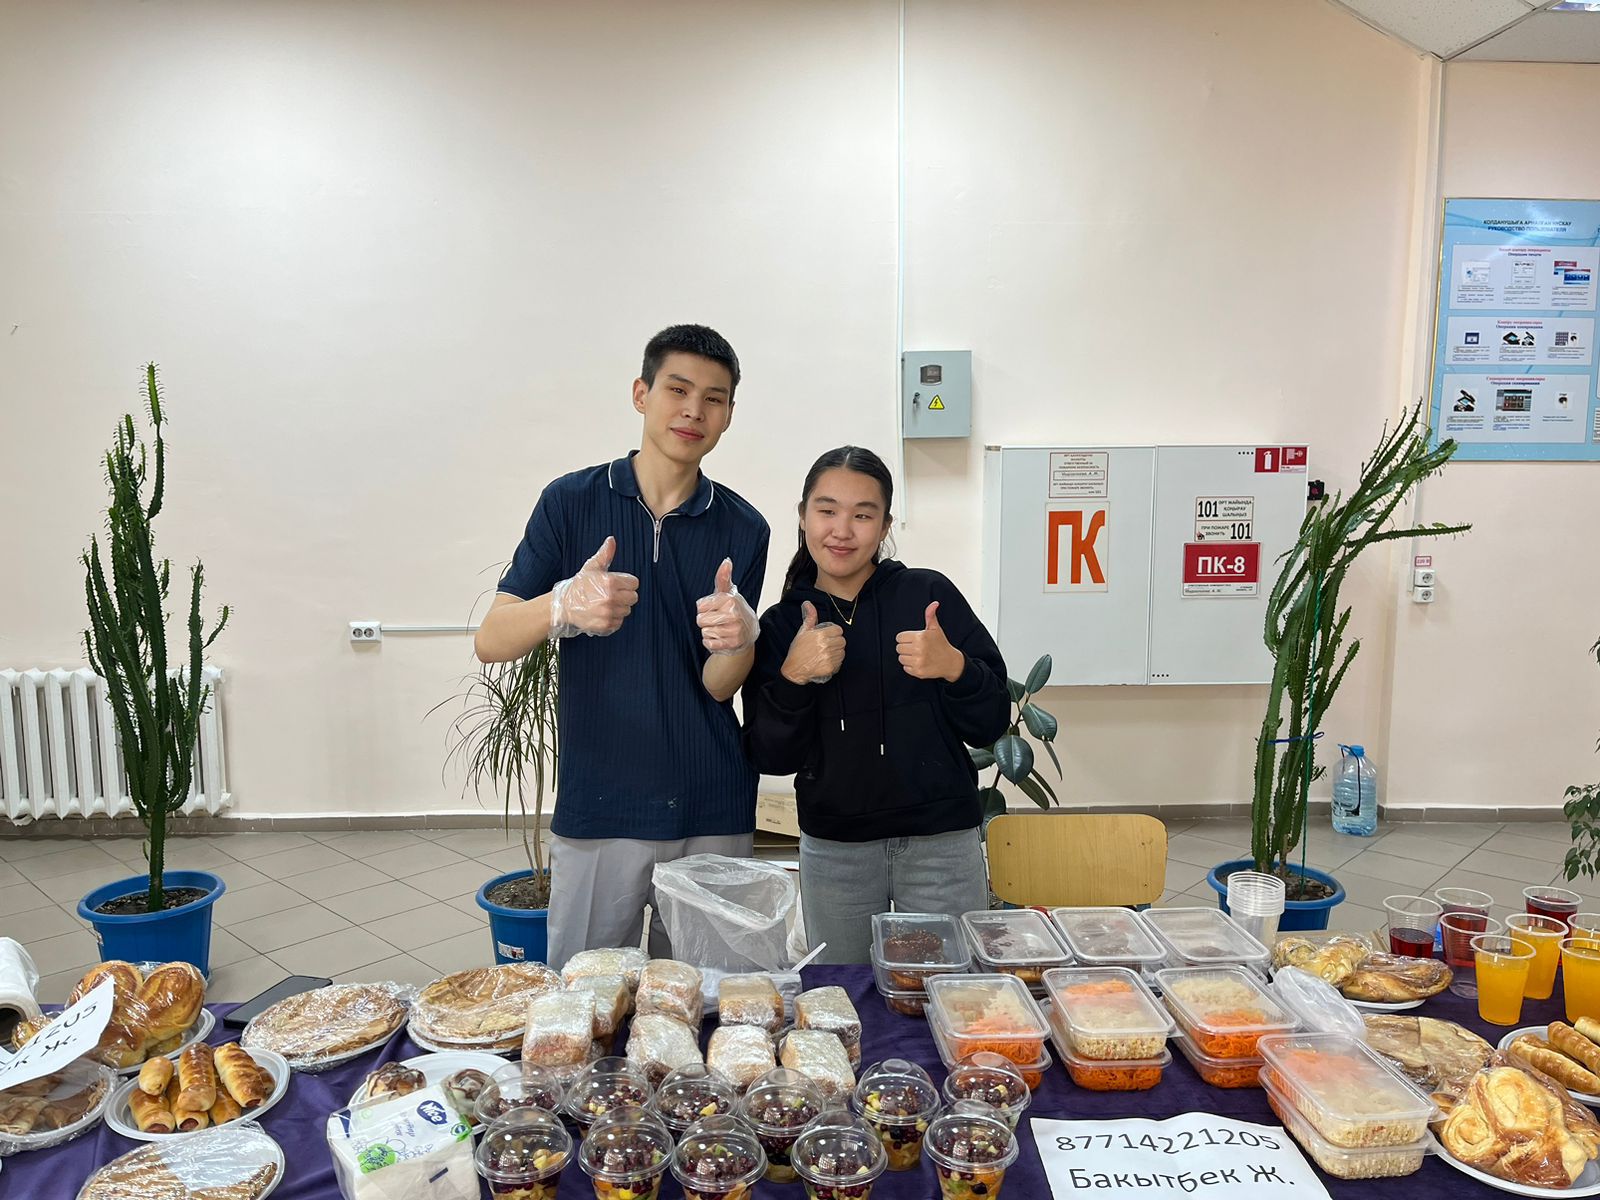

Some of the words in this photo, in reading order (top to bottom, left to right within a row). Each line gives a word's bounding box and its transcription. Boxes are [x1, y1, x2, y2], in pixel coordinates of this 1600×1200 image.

[1198, 500, 1218, 517] 101
[1231, 523, 1251, 539] 101
[1047, 510, 1105, 584] ПК
[1198, 556, 1245, 573] ПК-8
[1055, 1128, 1281, 1154] 87714221205
[1069, 1167, 1242, 1193] Бакытбек
[1246, 1164, 1295, 1186] Ж.
